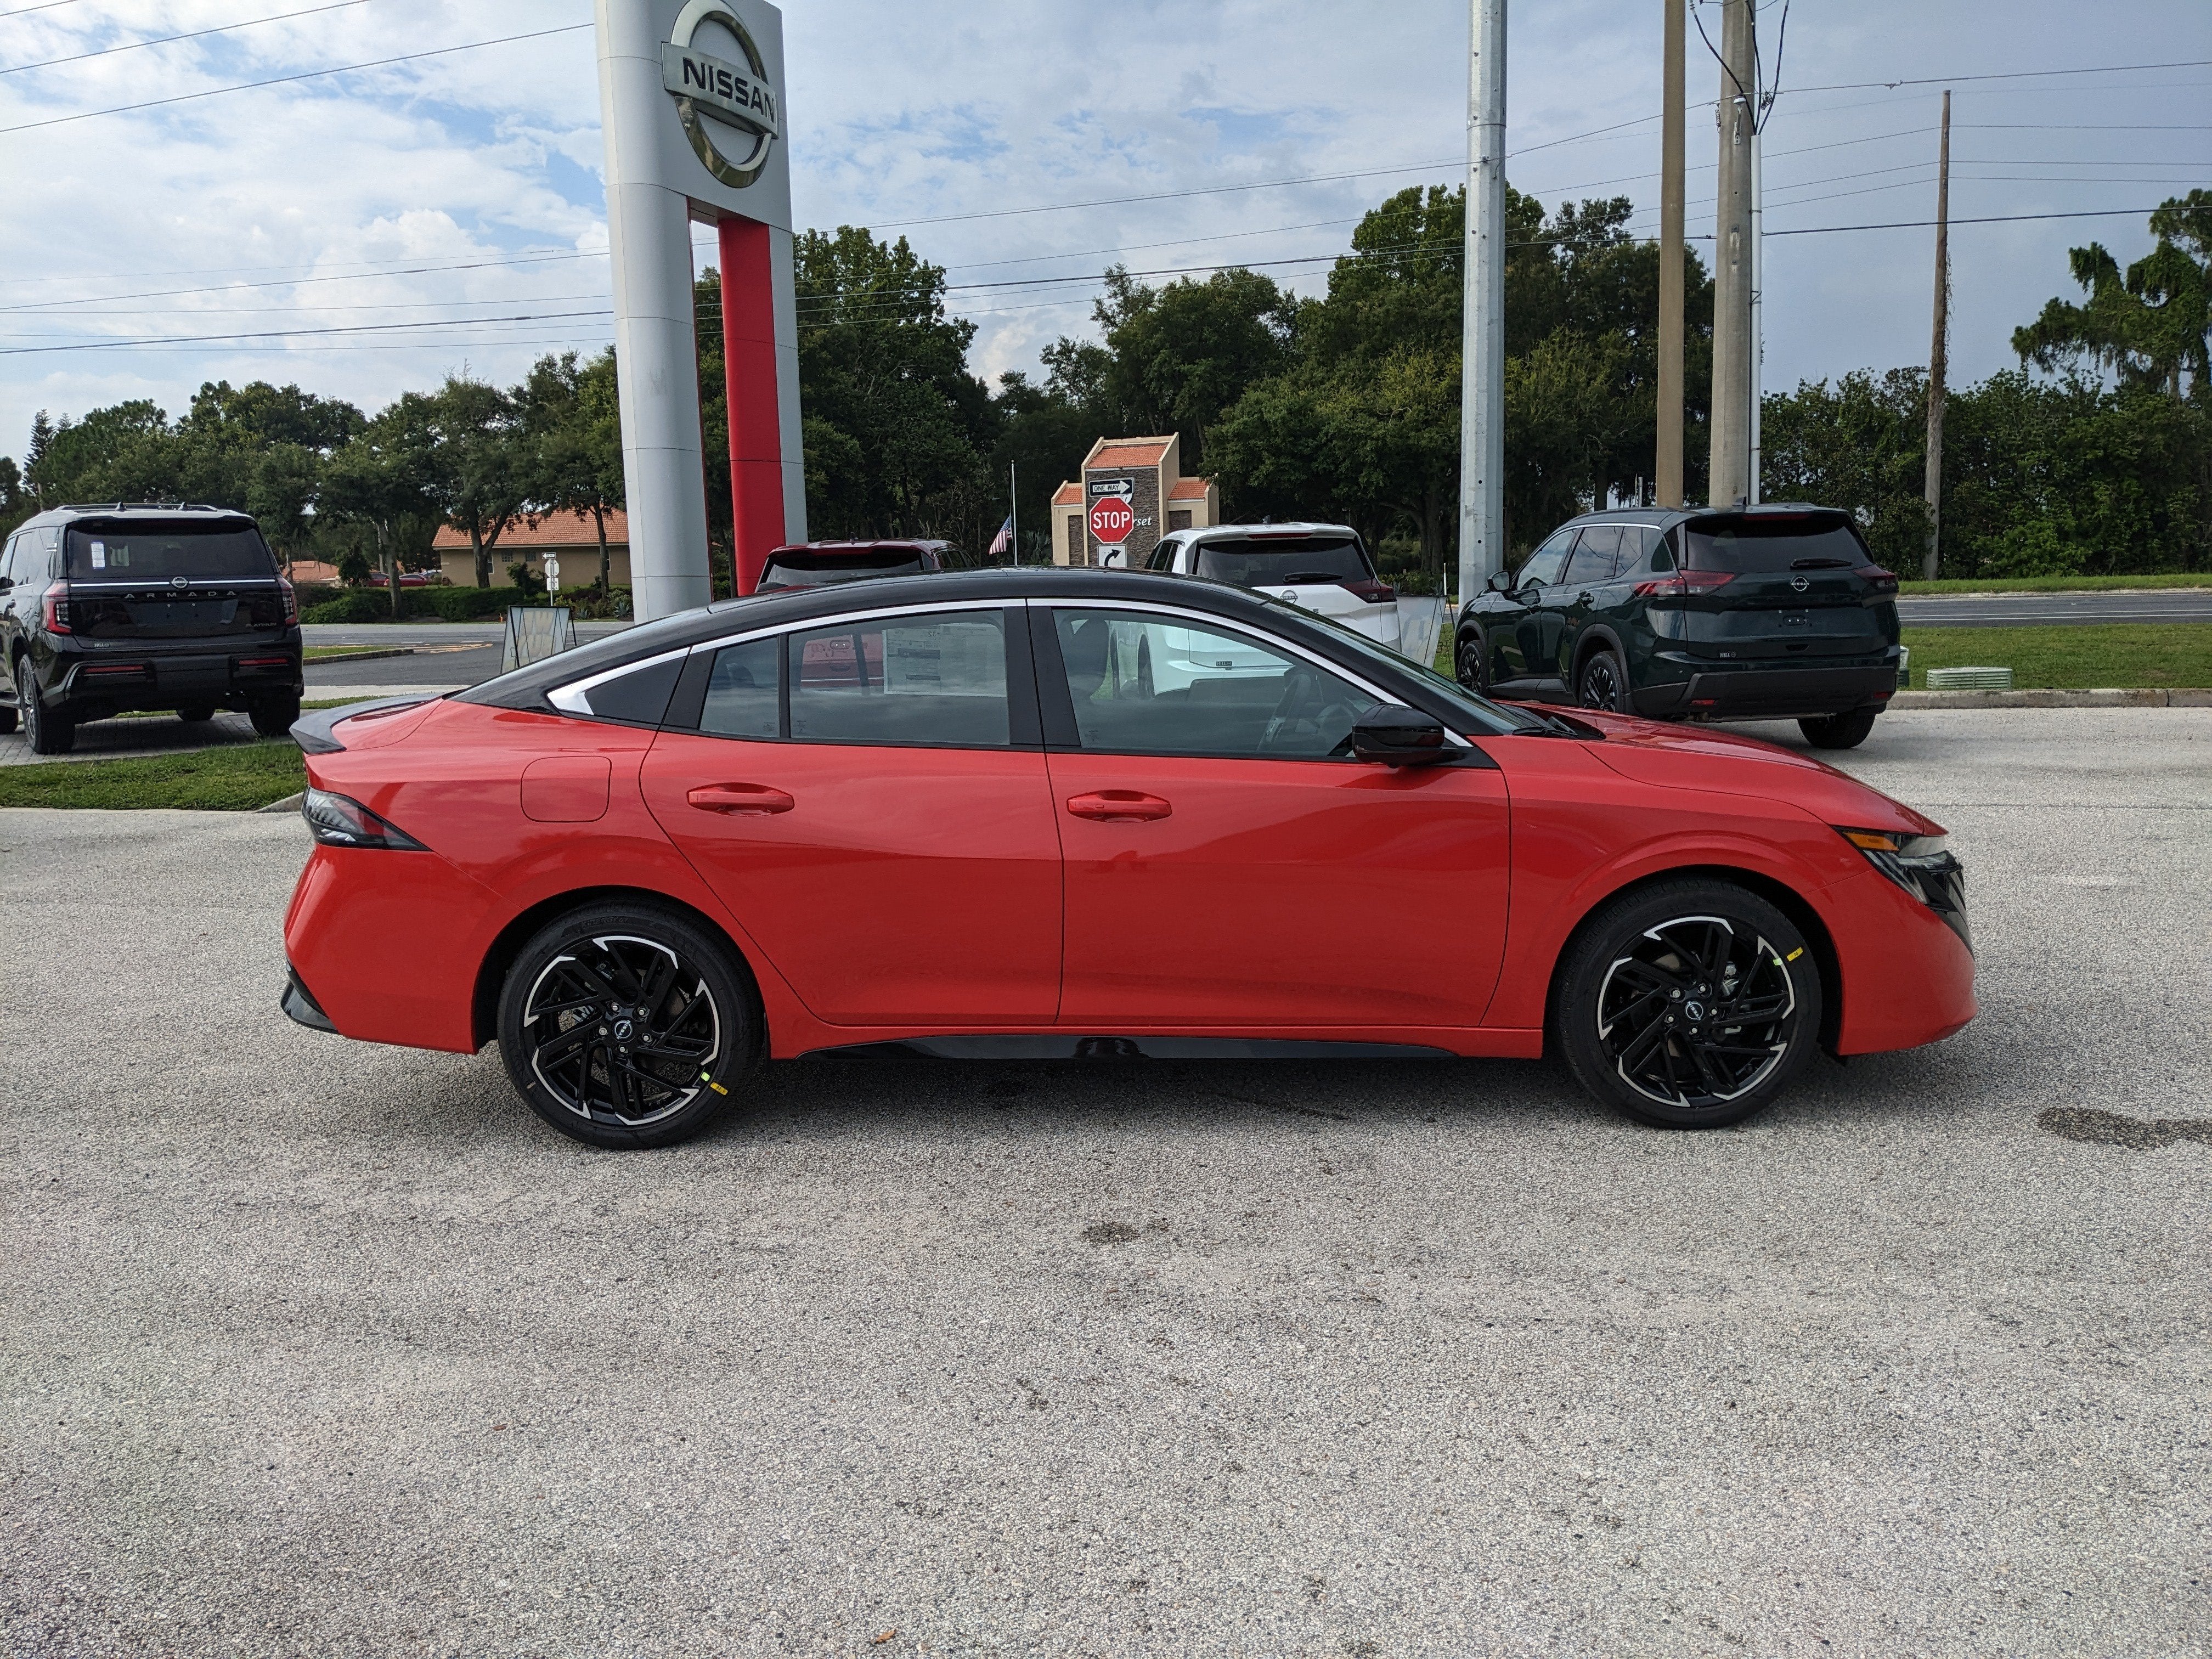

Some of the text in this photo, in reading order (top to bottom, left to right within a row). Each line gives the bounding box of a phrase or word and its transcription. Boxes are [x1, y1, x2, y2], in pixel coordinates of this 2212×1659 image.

[682, 57, 775, 123] NISSAN
[1093, 511, 1130, 529] STOP
[125, 590, 236, 599] ARMADA
